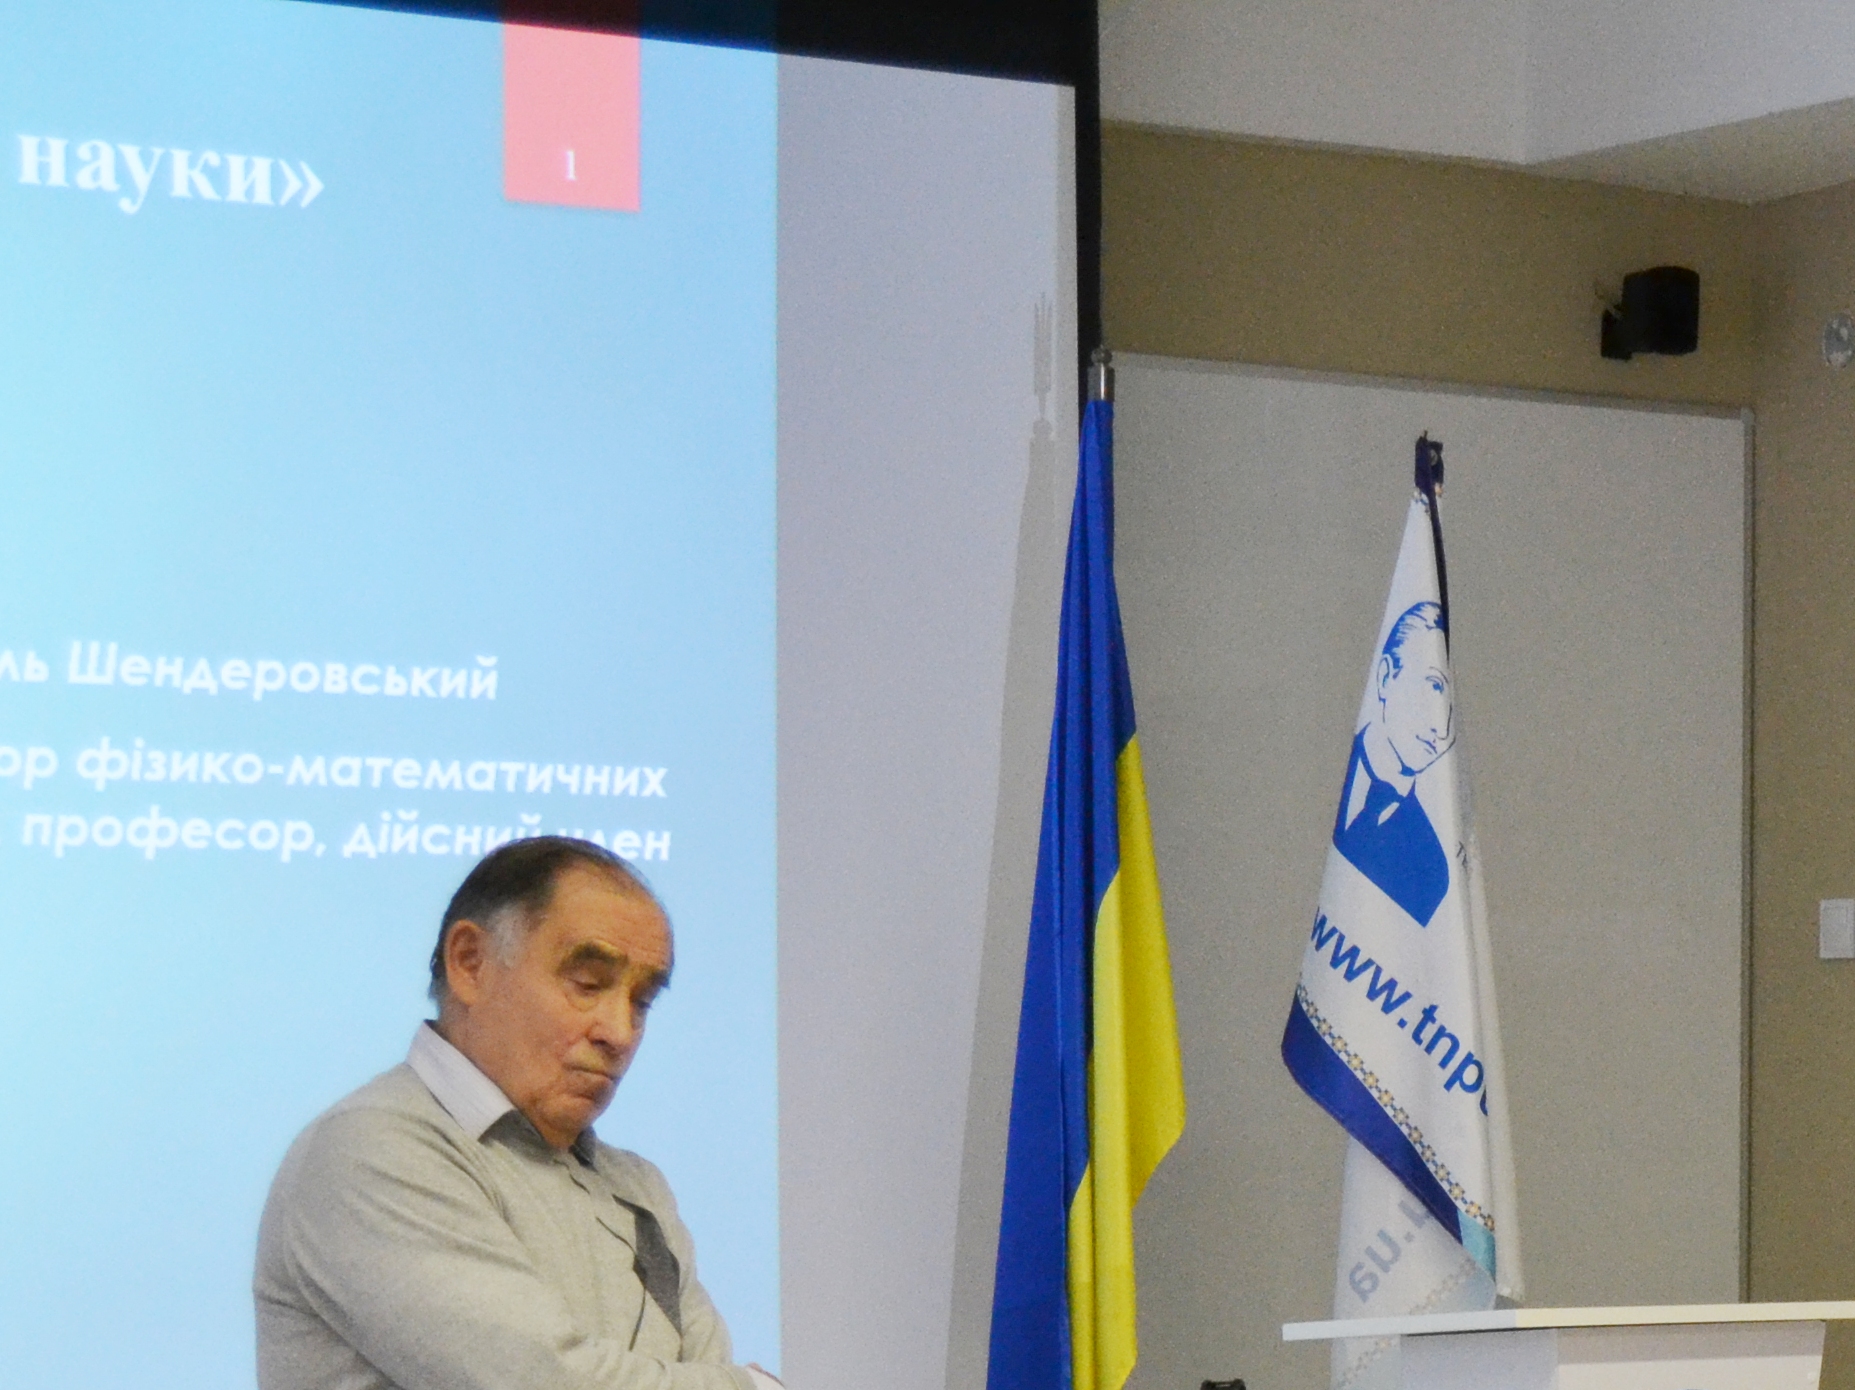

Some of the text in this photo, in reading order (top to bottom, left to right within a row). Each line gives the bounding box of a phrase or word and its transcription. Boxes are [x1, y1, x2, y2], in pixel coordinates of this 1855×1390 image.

[17, 133, 325, 215] науки»
[563, 149, 578, 182] 1
[67, 640, 499, 702] Шендеровський
[76, 735, 669, 799] фізико-математичних
[22, 804, 328, 863] професор,
[558, 828, 672, 861] ен
